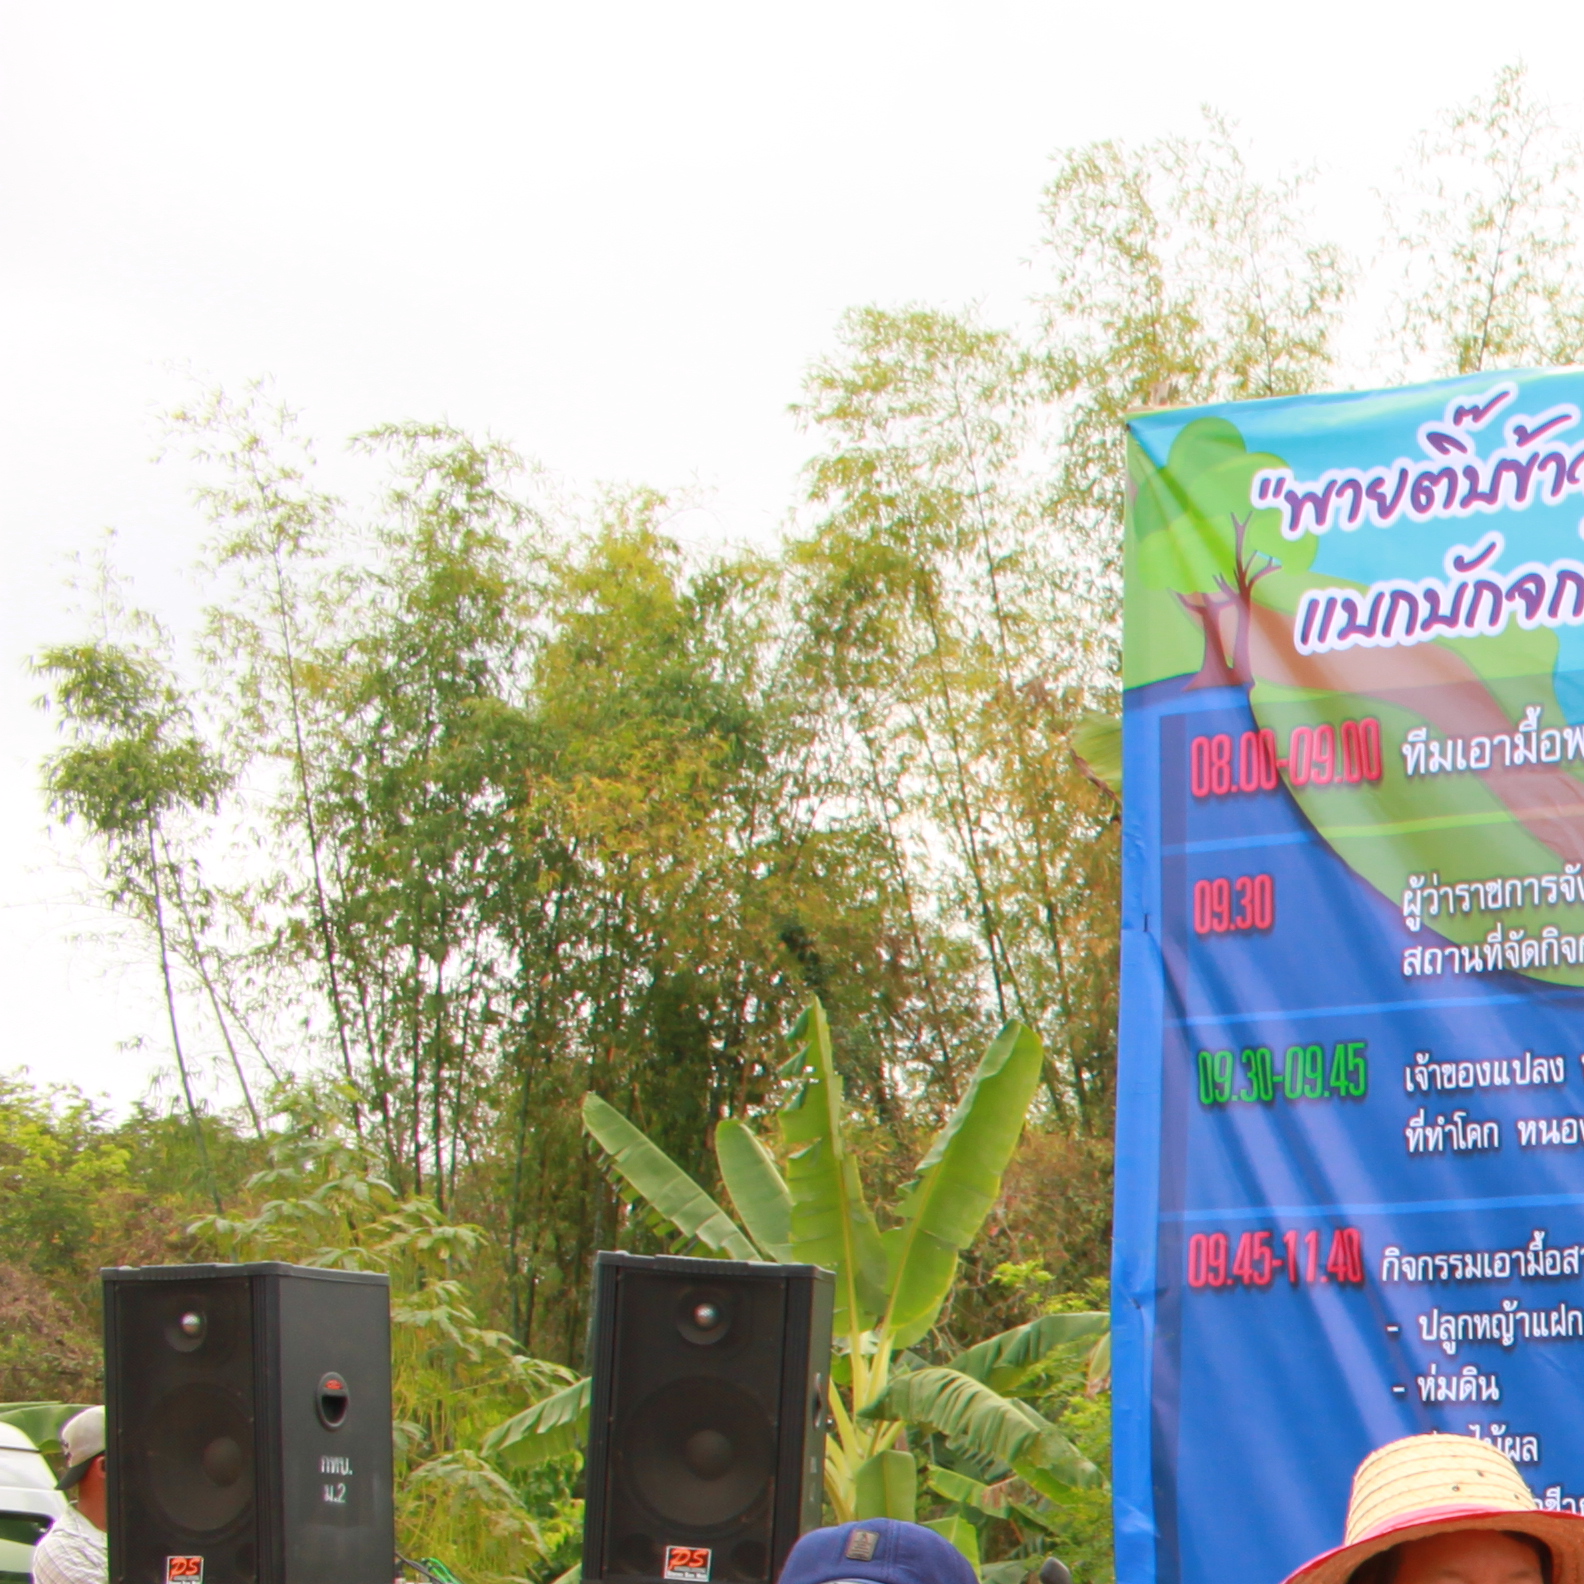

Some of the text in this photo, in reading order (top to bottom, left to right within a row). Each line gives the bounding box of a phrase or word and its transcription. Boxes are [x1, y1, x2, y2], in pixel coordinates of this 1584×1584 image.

[1189, 716, 1382, 798] 08.00-09.00
[1193, 874, 1274, 935] 09.30
[1197, 1041, 1368, 1106] 09.30-09.45
[1404, 1051, 1565, 1093] เจ้าของแปลง
[1188, 1226, 1365, 1290] 09.45-11.40
[1418, 1299, 1584, 1355] ปลูกหญ้าแฝก
[1417, 1363, 1500, 1402] ห่มดิน
